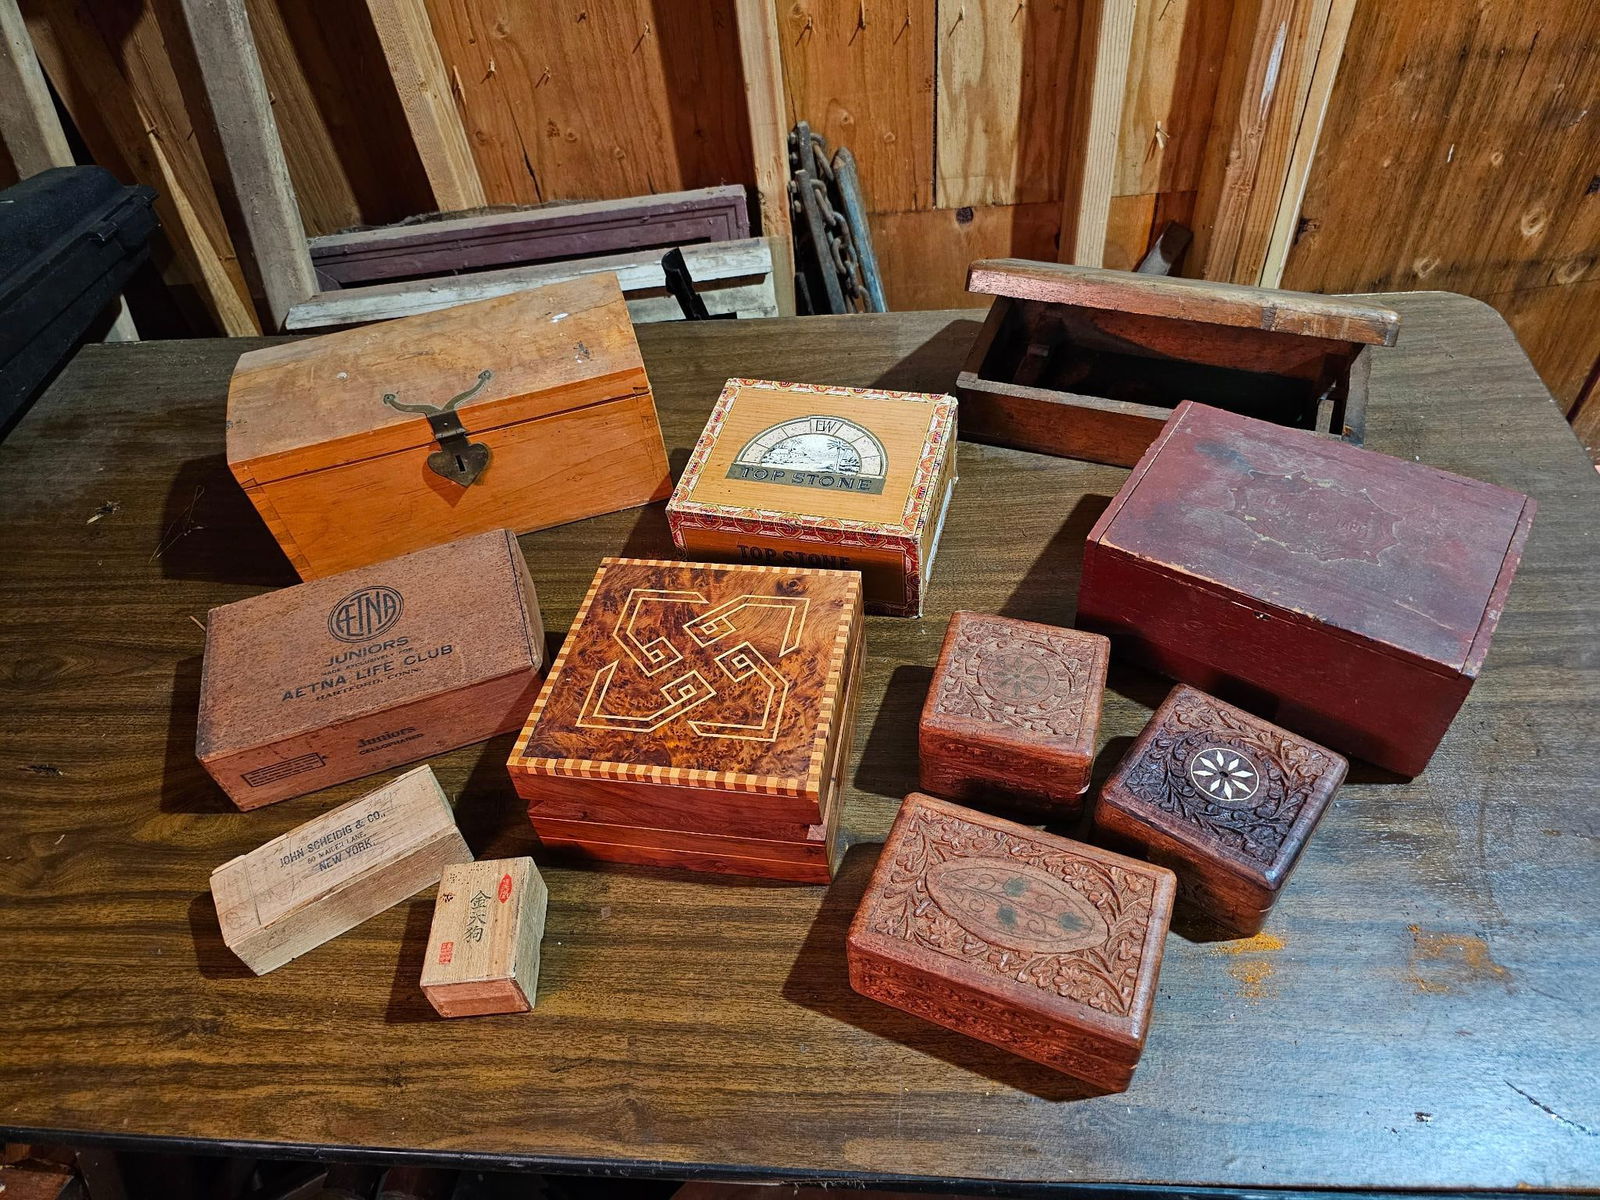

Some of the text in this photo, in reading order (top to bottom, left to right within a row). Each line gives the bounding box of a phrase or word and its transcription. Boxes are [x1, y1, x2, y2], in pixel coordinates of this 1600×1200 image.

[740, 466, 873, 491] TOP STONE
[736, 544, 851, 569] TOP STONE
[325, 636, 410, 668] JUNIORS
[281, 643, 453, 702] AETNA LIFE CLUB
[356, 725, 417, 749] Juniors
[279, 847, 305, 868] JOHN
[307, 824, 353, 854] SCHEIDIG
[354, 818, 366, 830] &
[319, 851, 343, 872] NEW
